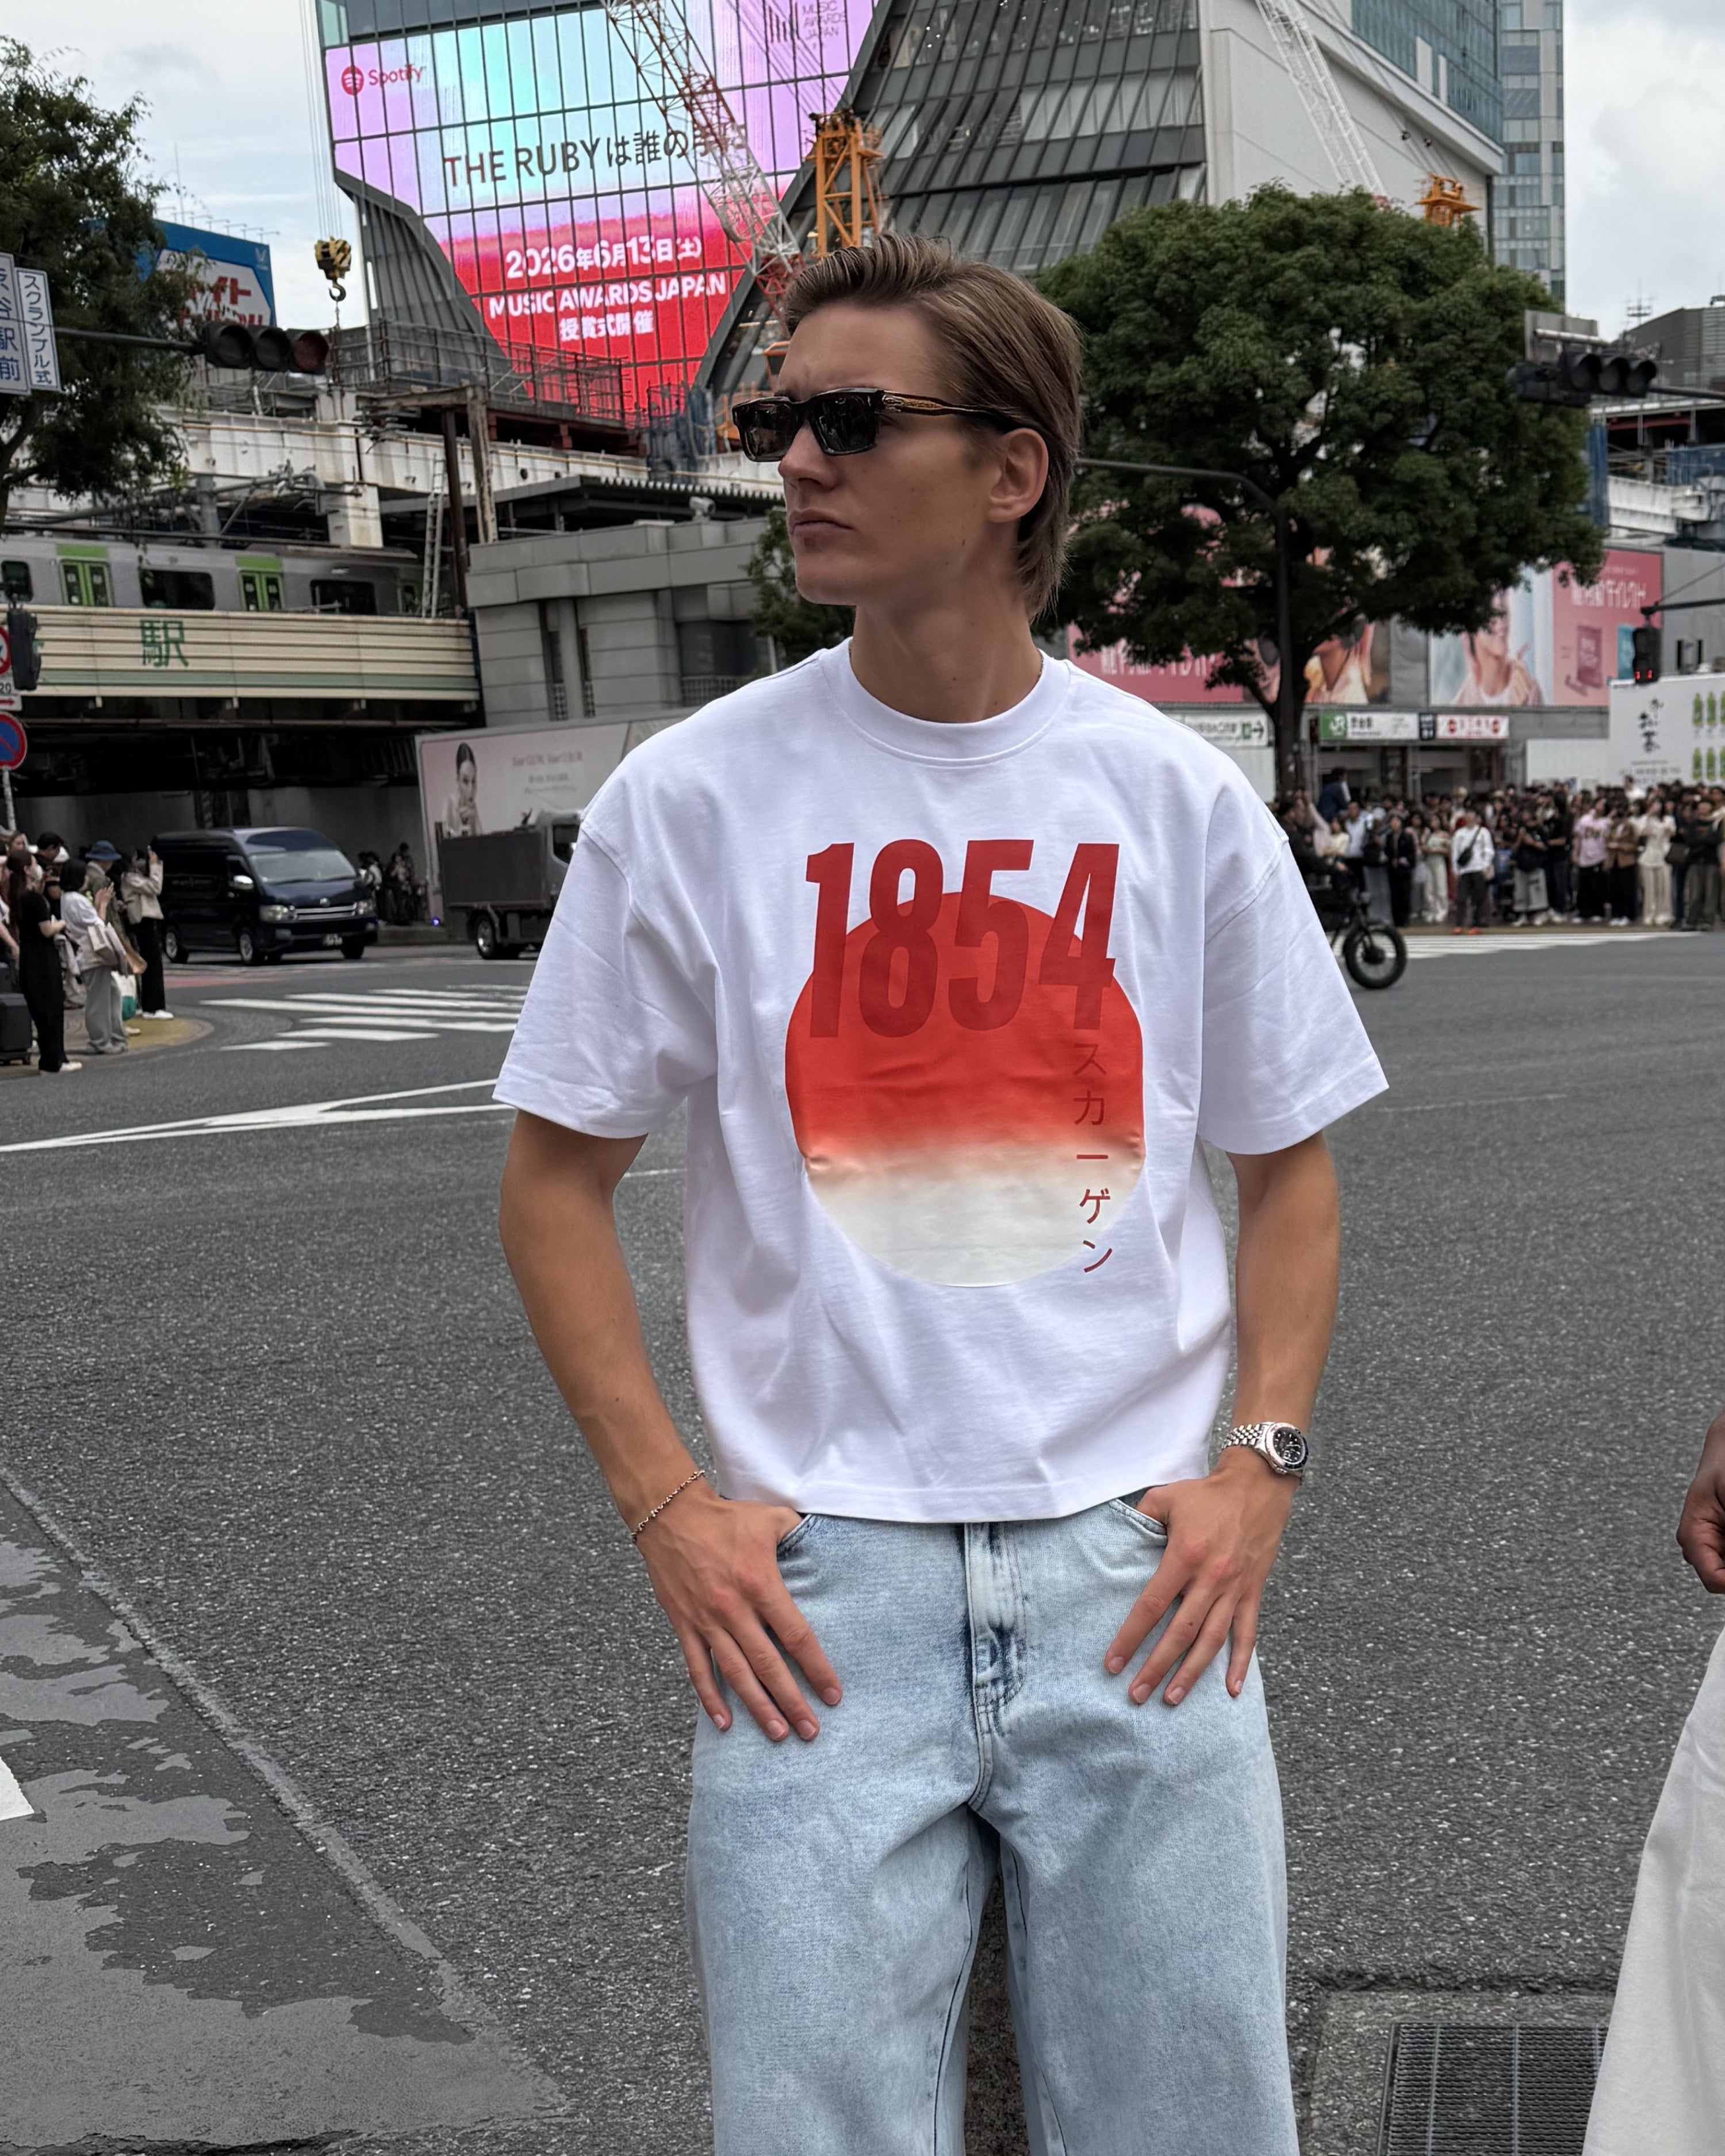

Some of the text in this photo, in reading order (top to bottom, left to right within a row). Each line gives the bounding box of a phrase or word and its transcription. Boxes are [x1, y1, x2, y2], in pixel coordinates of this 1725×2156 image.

[368, 64, 423, 88] Spotify
[444, 149, 507, 186] THE
[489, 273, 726, 319] MUSIC AWARDS JAPAN
[140, 619, 189, 667] 駅
[806, 838, 1120, 1038] 1854
[1072, 1043, 1113, 1273] スカーゲン
